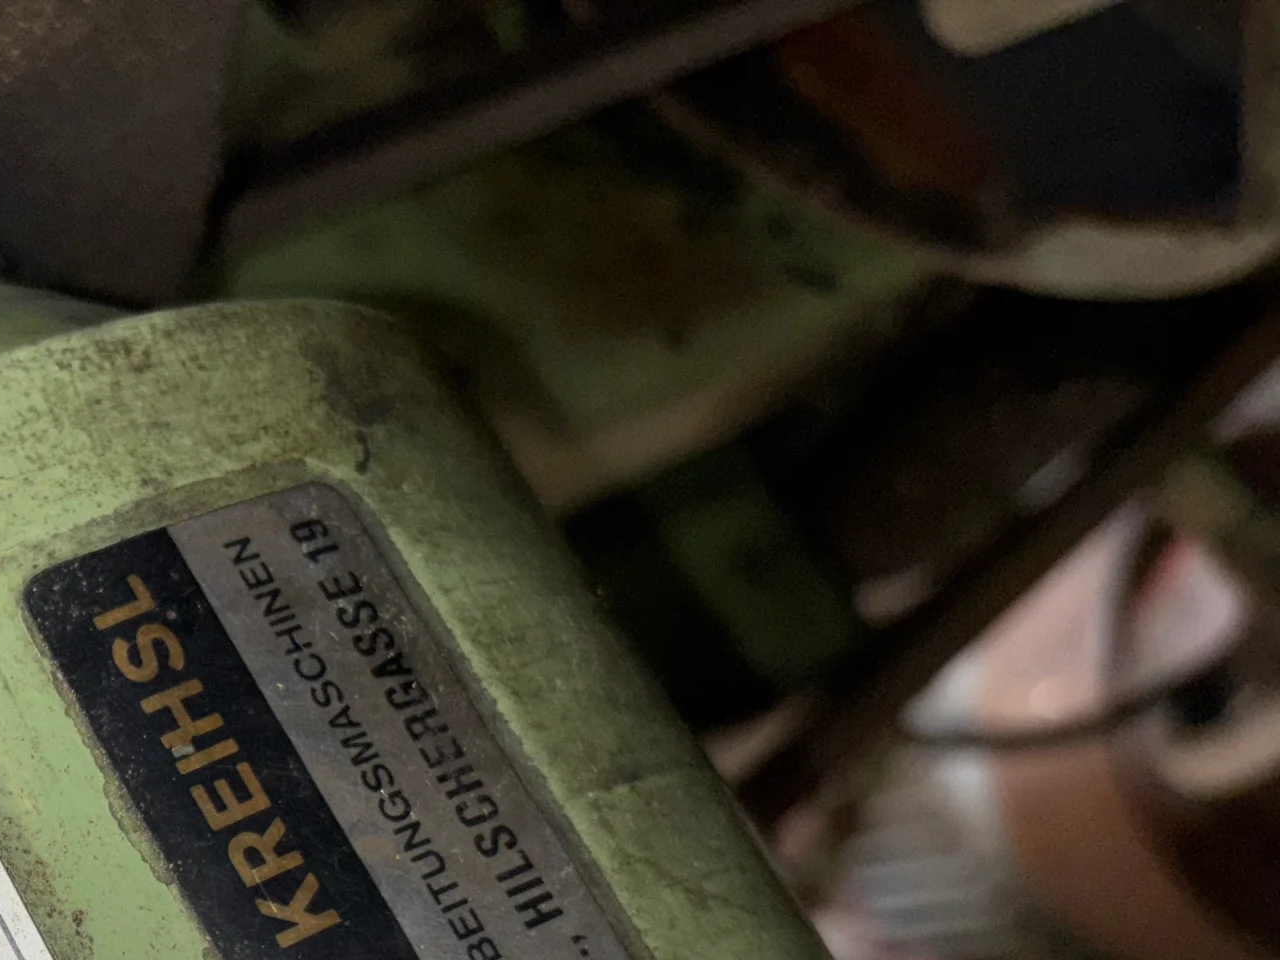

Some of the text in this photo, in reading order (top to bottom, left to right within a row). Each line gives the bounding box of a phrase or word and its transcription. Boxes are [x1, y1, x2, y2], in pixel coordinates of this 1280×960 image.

[288, 518, 342, 565] 19
[90, 572, 342, 949] KREIHSL
[317, 569, 565, 931] HILSCHERGASSE
